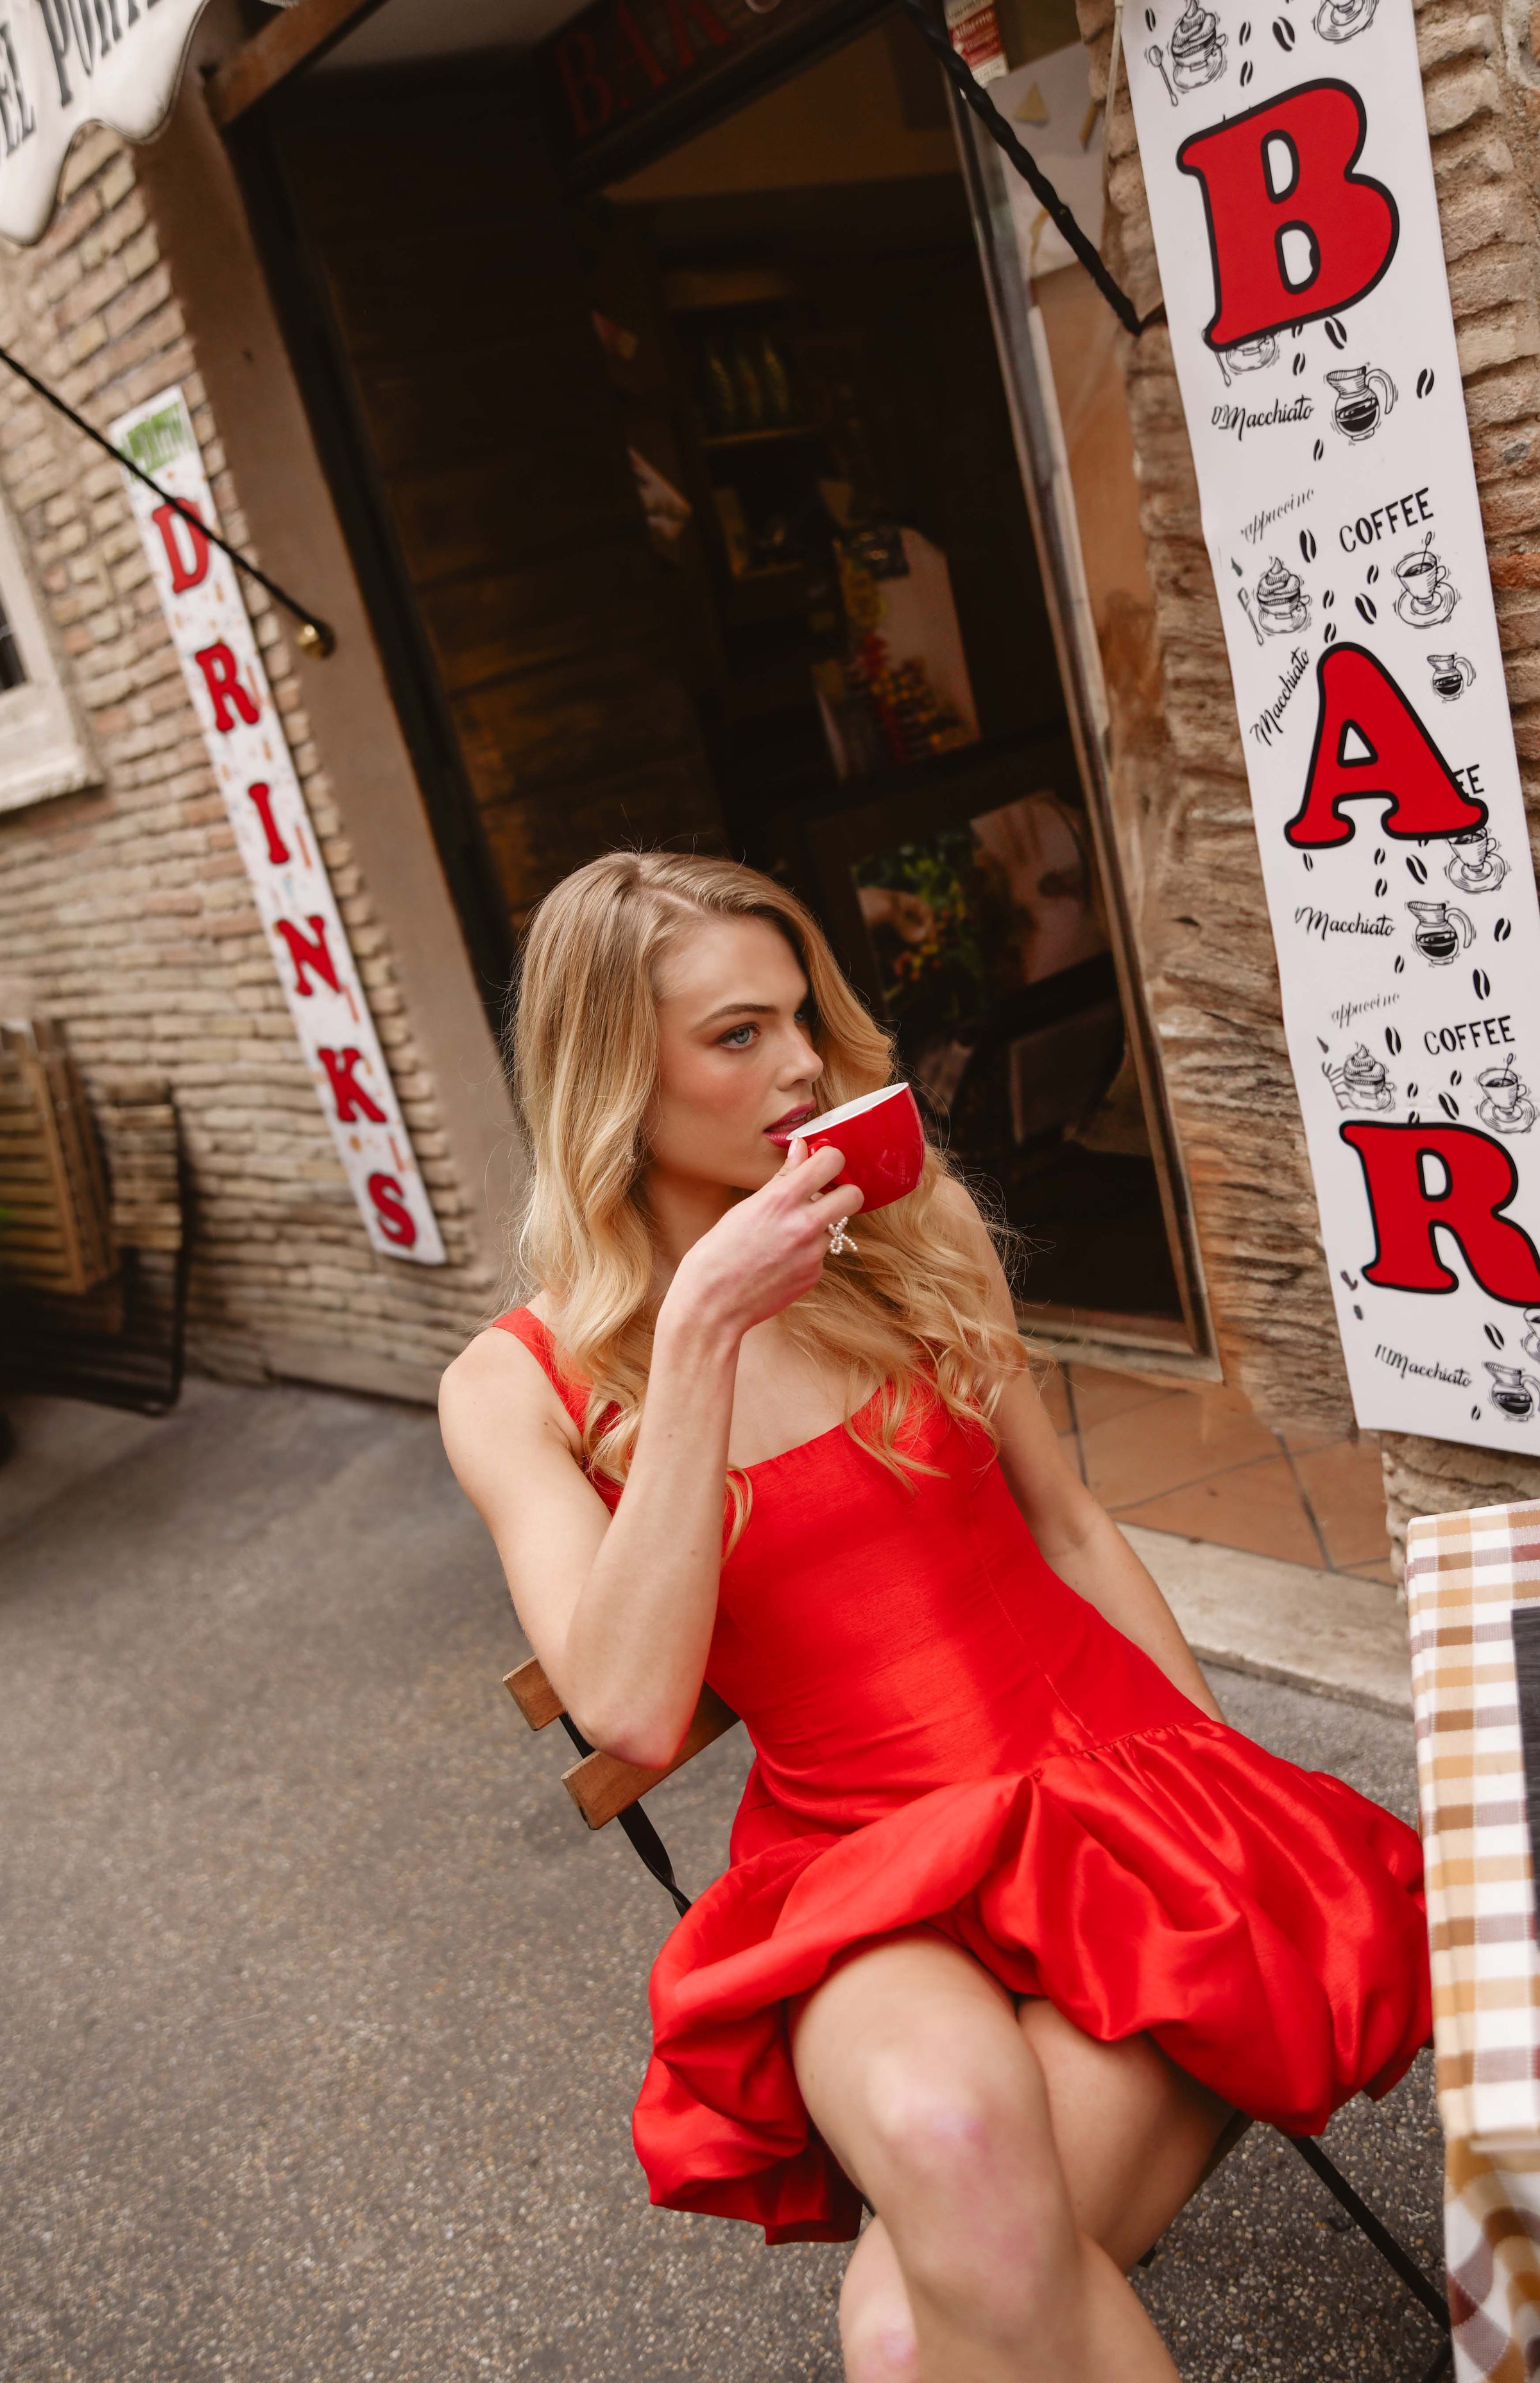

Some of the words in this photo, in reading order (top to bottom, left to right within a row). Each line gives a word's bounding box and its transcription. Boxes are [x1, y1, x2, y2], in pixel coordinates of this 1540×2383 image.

[1339, 486, 1434, 553] COFFEE
[1177, 78, 1540, 1308] BAR
[1250, 646, 1309, 746] Macchiato
[152, 496, 417, 1247] DRINKS
[1295, 906, 1395, 942] Macchiato
[1423, 1015, 1515, 1055] COFFEE
